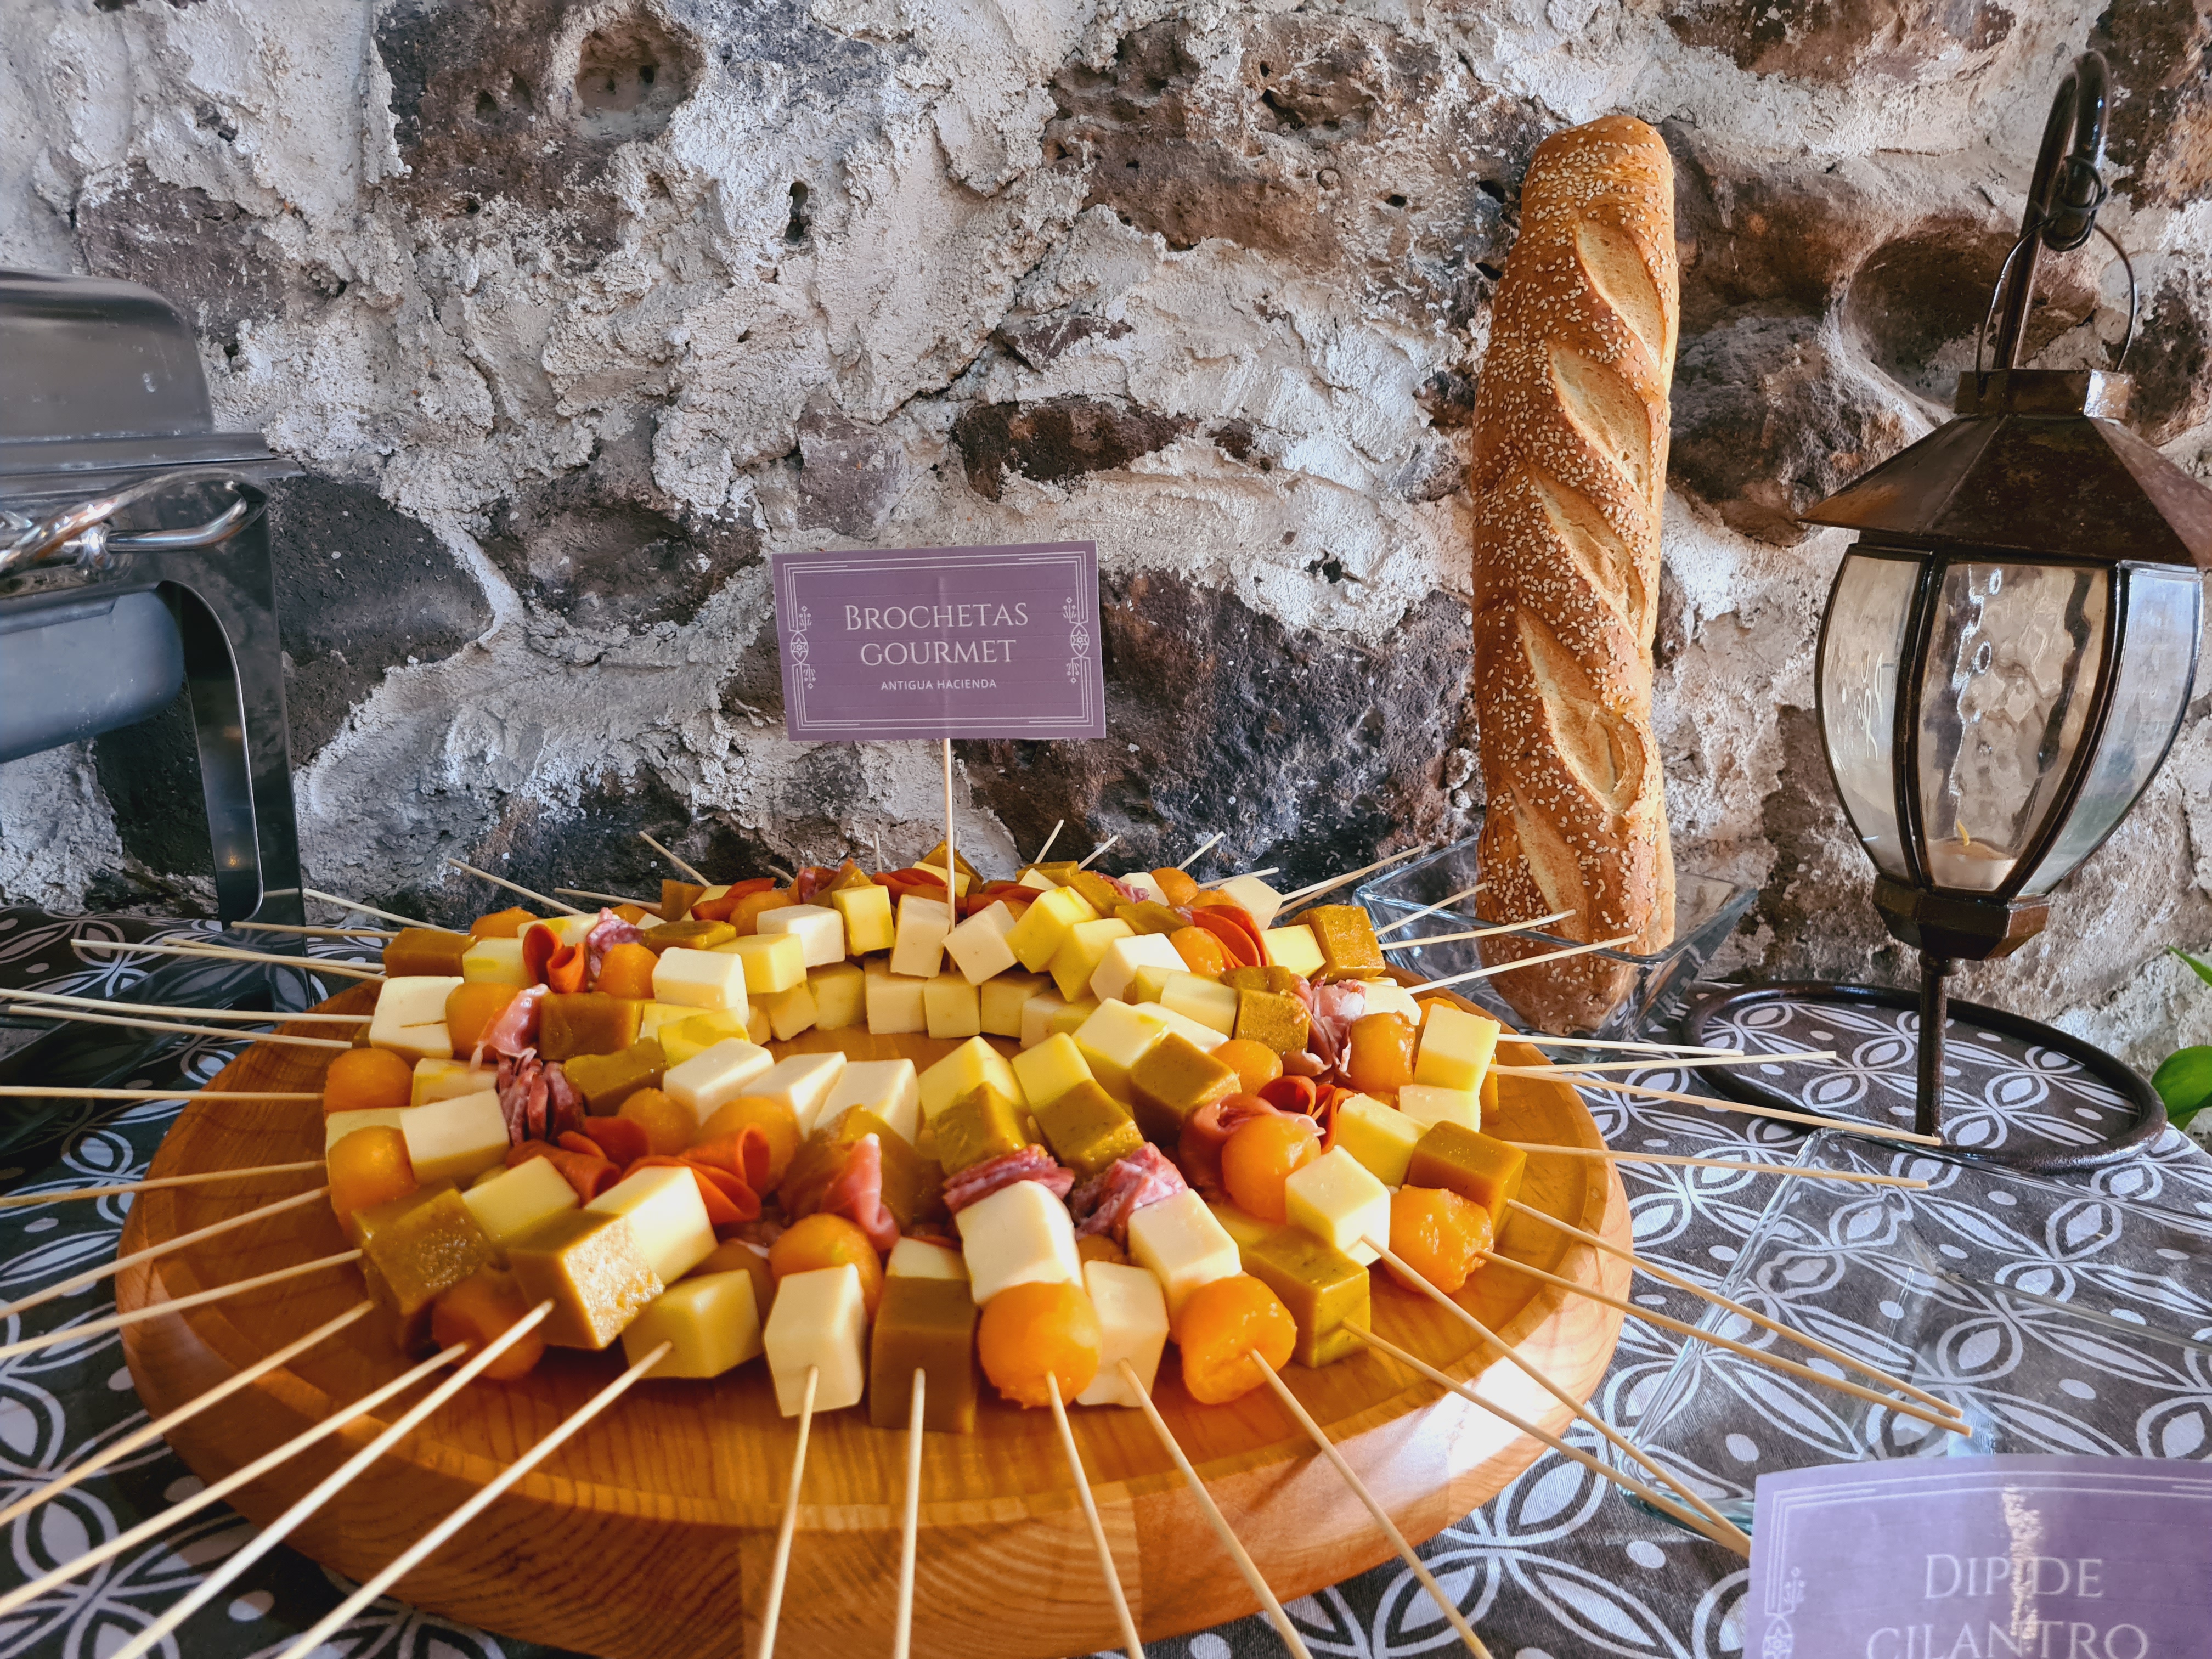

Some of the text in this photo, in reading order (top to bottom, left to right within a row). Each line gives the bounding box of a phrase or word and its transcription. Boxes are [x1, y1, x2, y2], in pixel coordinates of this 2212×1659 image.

[845, 602, 1029, 630] BROCHETAS
[860, 639, 1017, 666] GOURMET
[881, 678, 997, 691] ANTIGUA HACIENDA
[1924, 1553, 2103, 1599] DIP DE
[1866, 1621, 2149, 1659] CILANTRO
